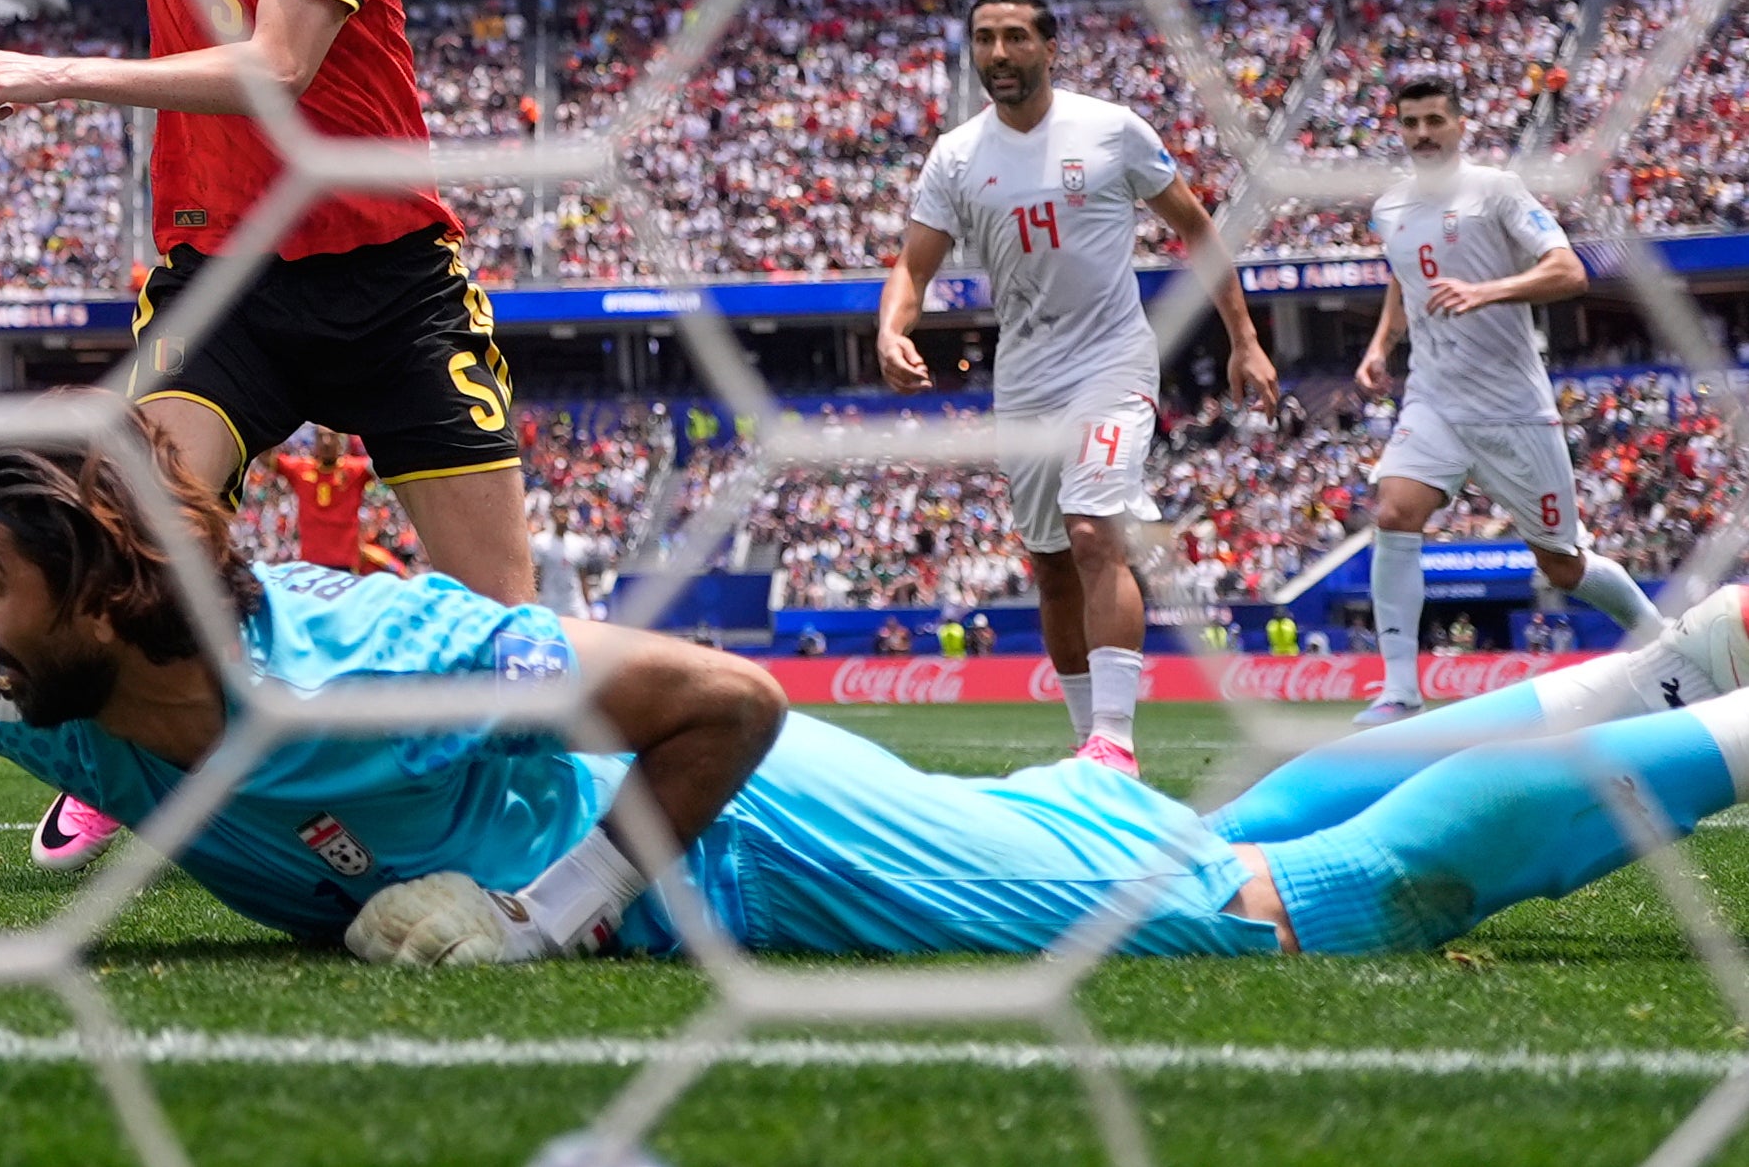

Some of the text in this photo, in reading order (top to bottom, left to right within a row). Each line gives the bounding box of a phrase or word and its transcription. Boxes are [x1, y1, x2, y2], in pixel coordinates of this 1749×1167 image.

[1011, 200, 1060, 254] 14
[1242, 261, 1393, 292] LOS ANGEL
[1419, 244, 1438, 279] 6
[449, 351, 506, 432] 5
[1077, 421, 1121, 467] 14
[1541, 493, 1561, 527] 6
[831, 656, 967, 704] Coca-Cola
[1220, 655, 1354, 703] Coca-Cola
